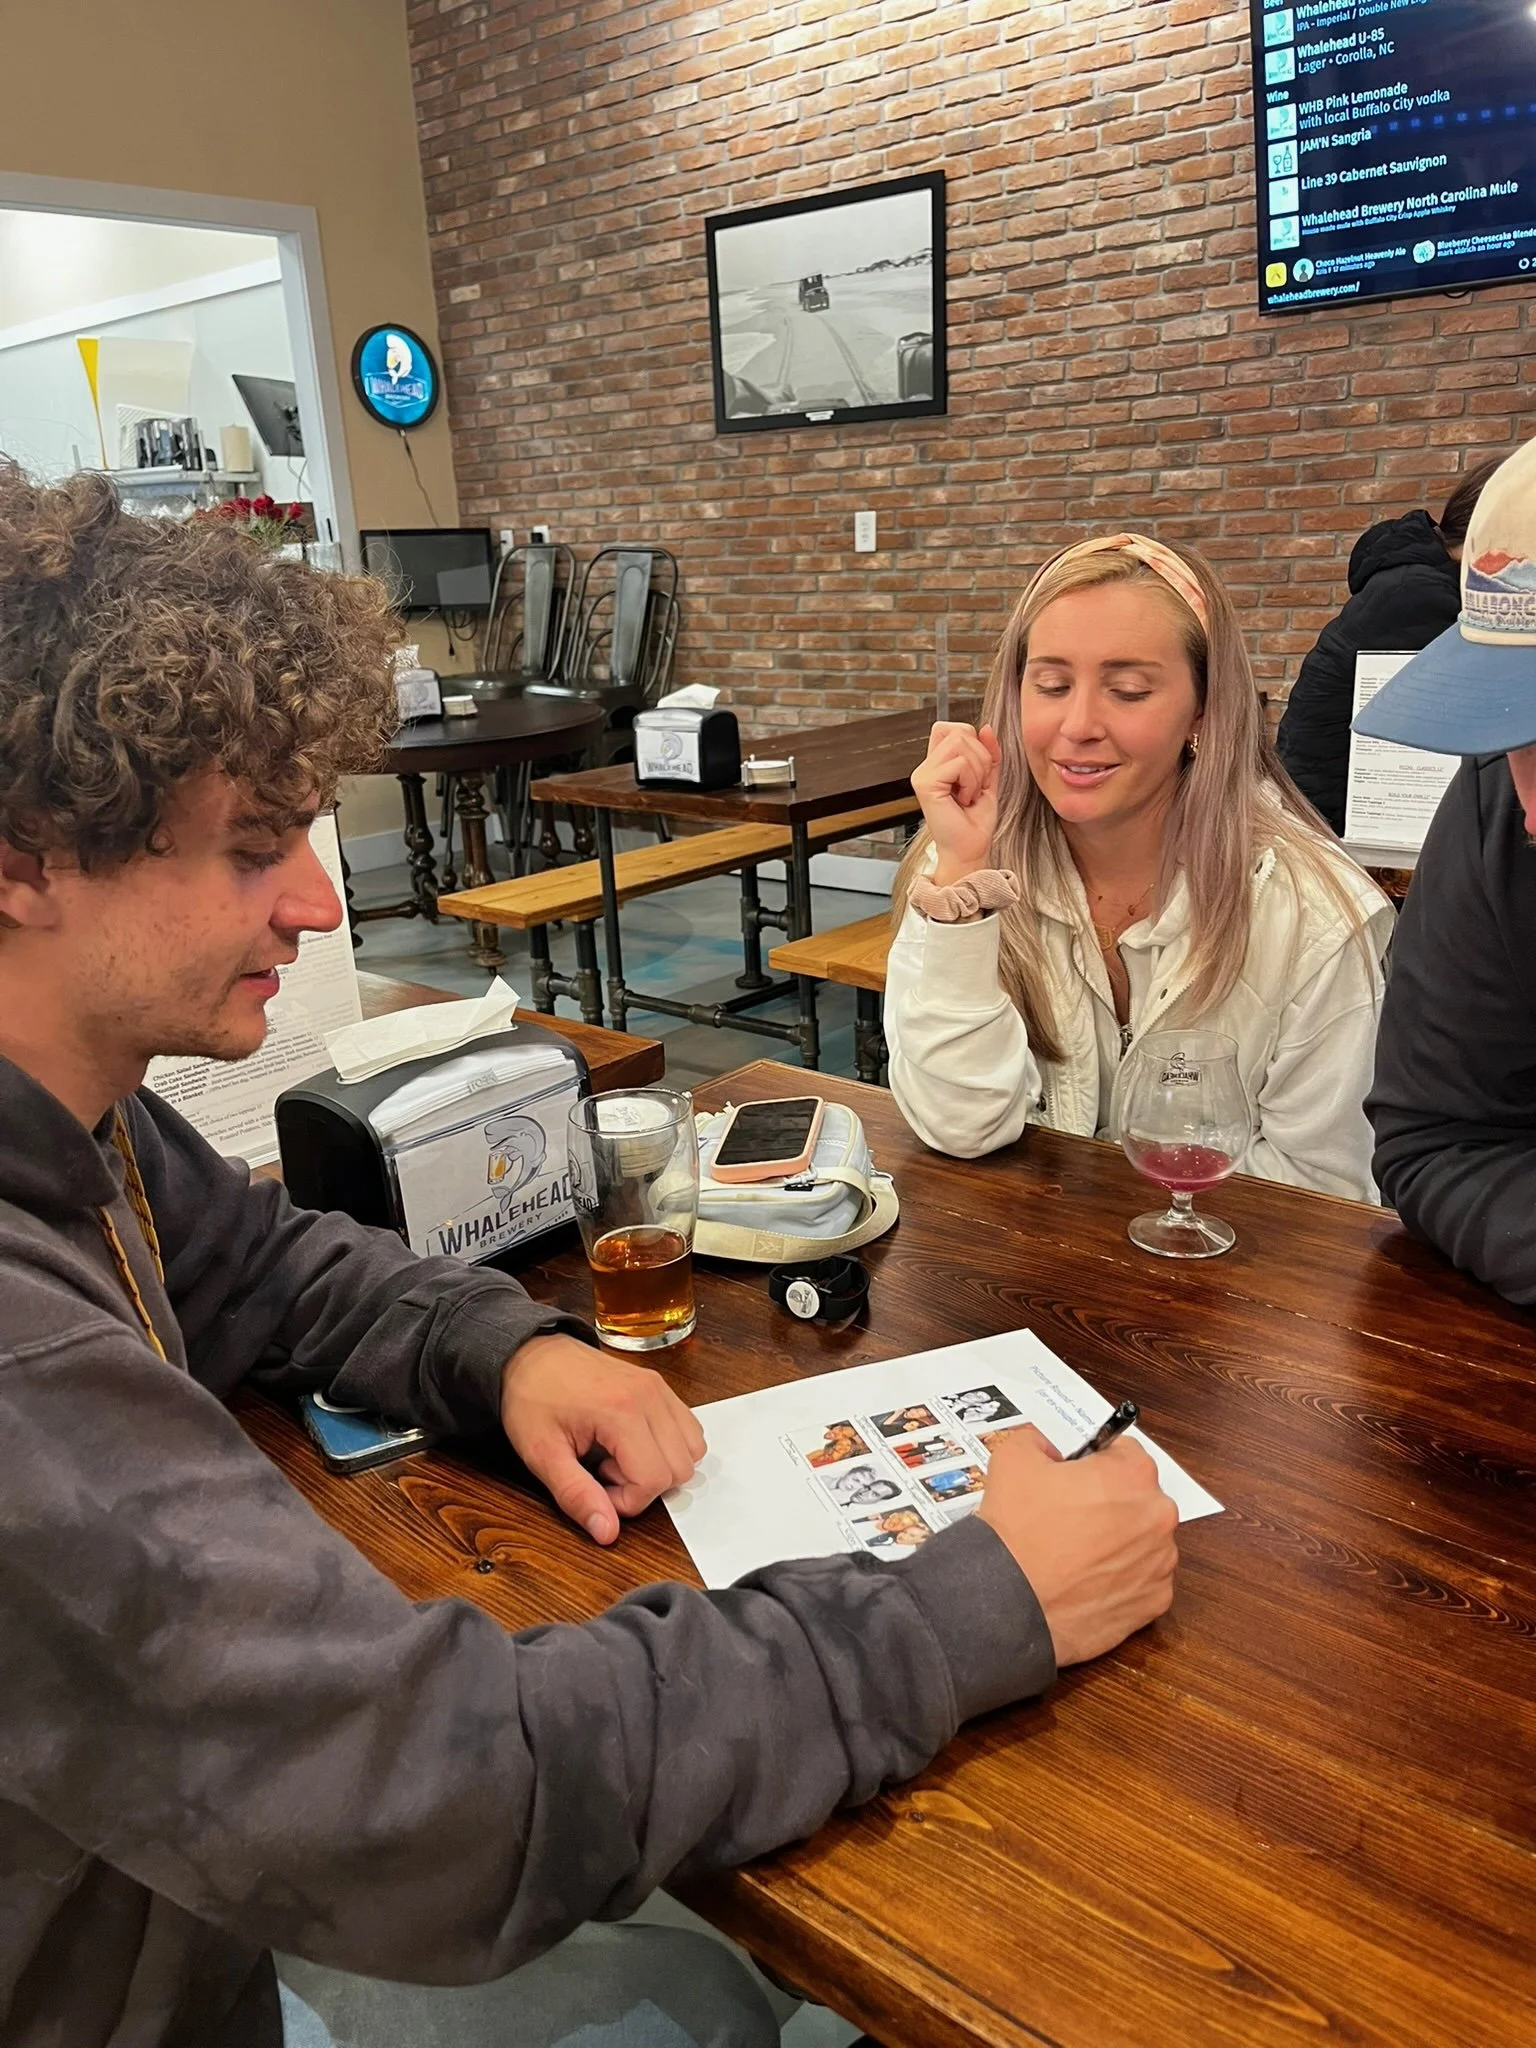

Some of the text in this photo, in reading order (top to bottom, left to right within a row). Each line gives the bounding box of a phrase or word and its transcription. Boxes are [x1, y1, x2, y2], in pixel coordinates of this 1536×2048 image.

[1316, 10, 1350, 28] Imperial
[1358, 1, 1389, 17] Double
[1296, 32, 1356, 59] Whalehead
[1358, 27, 1385, 45] U-85
[1298, 58, 1327, 74] Lager
[1335, 46, 1377, 66] Corolla,
[1378, 41, 1395, 56] NC
[1266, 89, 1290, 104] Wine
[1299, 82, 1409, 116] WHB Pink Lemonade
[1299, 114, 1322, 130] with
[1324, 108, 1351, 125] local
[1352, 101, 1391, 119] Buffalo
[1392, 96, 1415, 112] City
[1415, 89, 1451, 107] vodka
[1299, 127, 1372, 155] JAM'N Sangria
[1301, 154, 1448, 190] Line 39 Cabernet Sauvignon
[1301, 179, 1519, 227] Whalehead Brewery North Carolina Mule
[1386, 213, 1397, 222] City
[1437, 238, 1471, 251] Blueberry
[1471, 231, 1512, 245] Cheesecake
[1486, 242, 1502, 251] hour
[1502, 240, 1516, 249] ago
[1363, 260, 1376, 270] ago
[1364, 248, 1395, 260] Heavenly
[1267, 280, 1361, 304] whaleheadbrewery.com/
[180, 1075, 207, 1087] Sandwich
[183, 1067, 210, 1079] Sandwich
[180, 1083, 207, 1094] Sandwich
[182, 1090, 204, 1101] Blanket
[438, 1173, 573, 1256] WHALEHEAD
[479, 1212, 543, 1249] BREWERY
